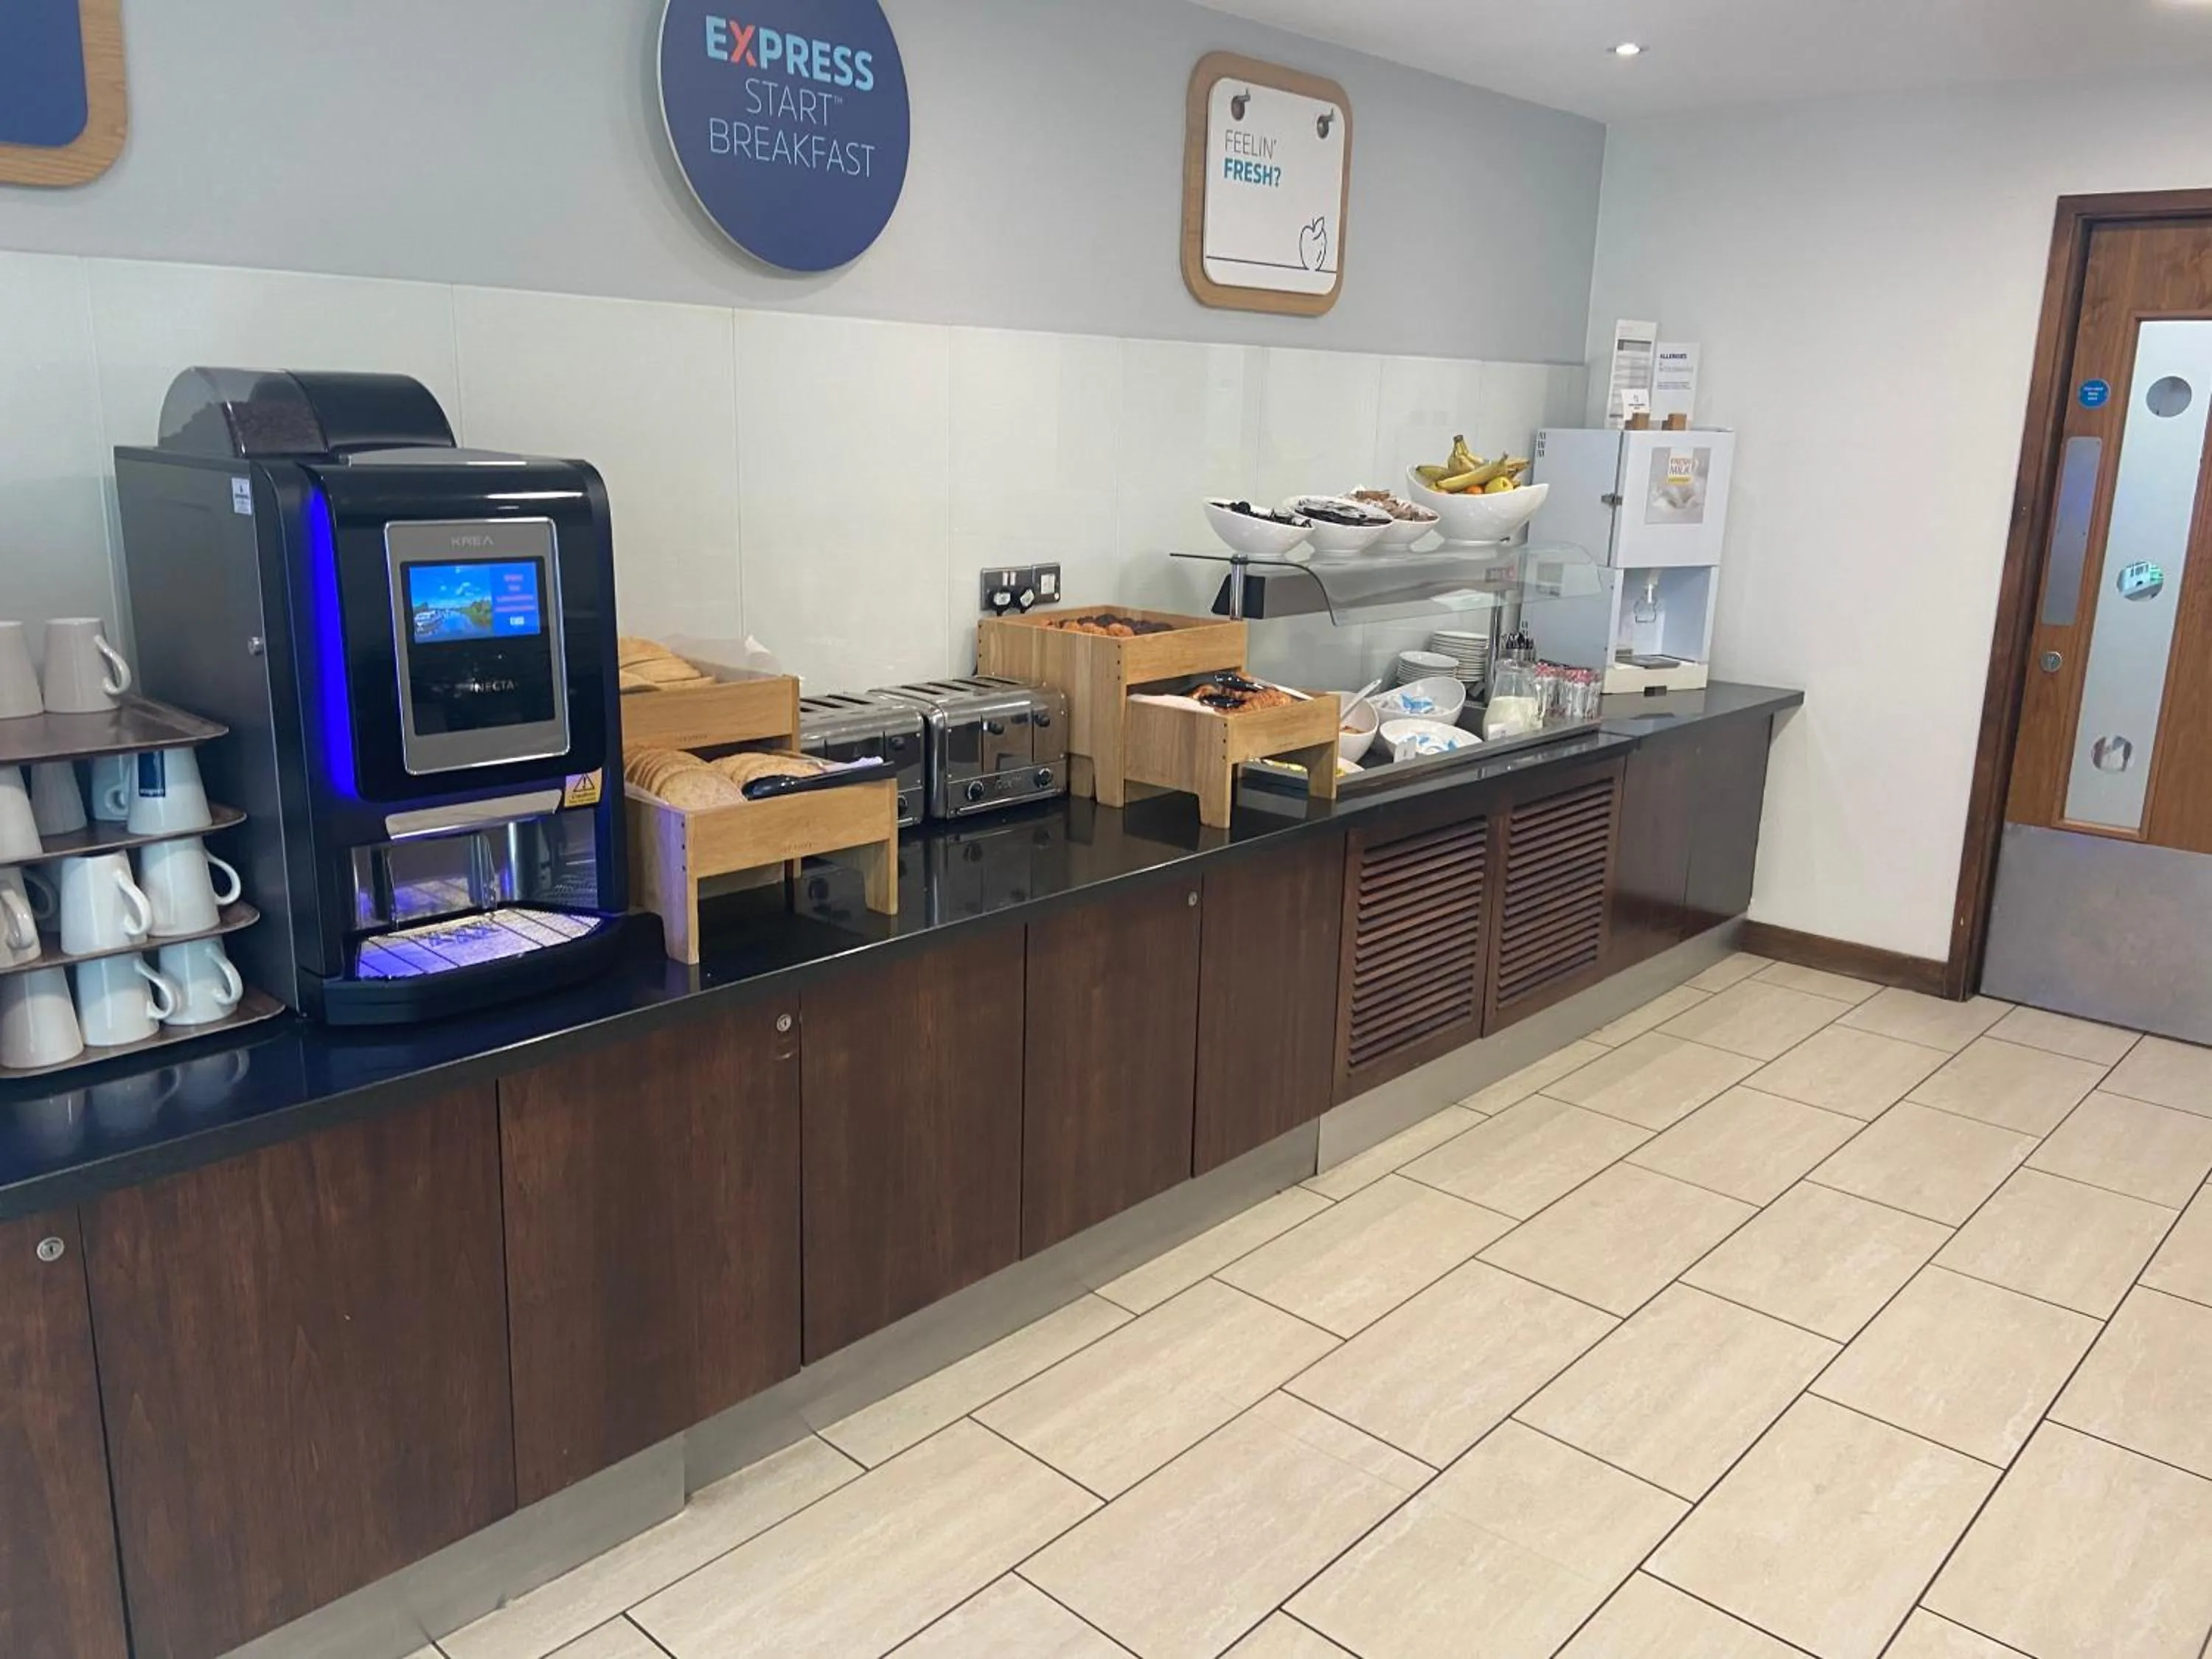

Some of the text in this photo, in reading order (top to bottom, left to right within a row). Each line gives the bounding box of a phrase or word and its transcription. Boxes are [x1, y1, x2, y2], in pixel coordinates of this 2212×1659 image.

[706, 15, 874, 91] EXPRESS
[709, 117, 874, 178] BREAKFAST
[1225, 129, 1277, 159] FEELIN'
[1223, 158, 1281, 187] FRESH?
